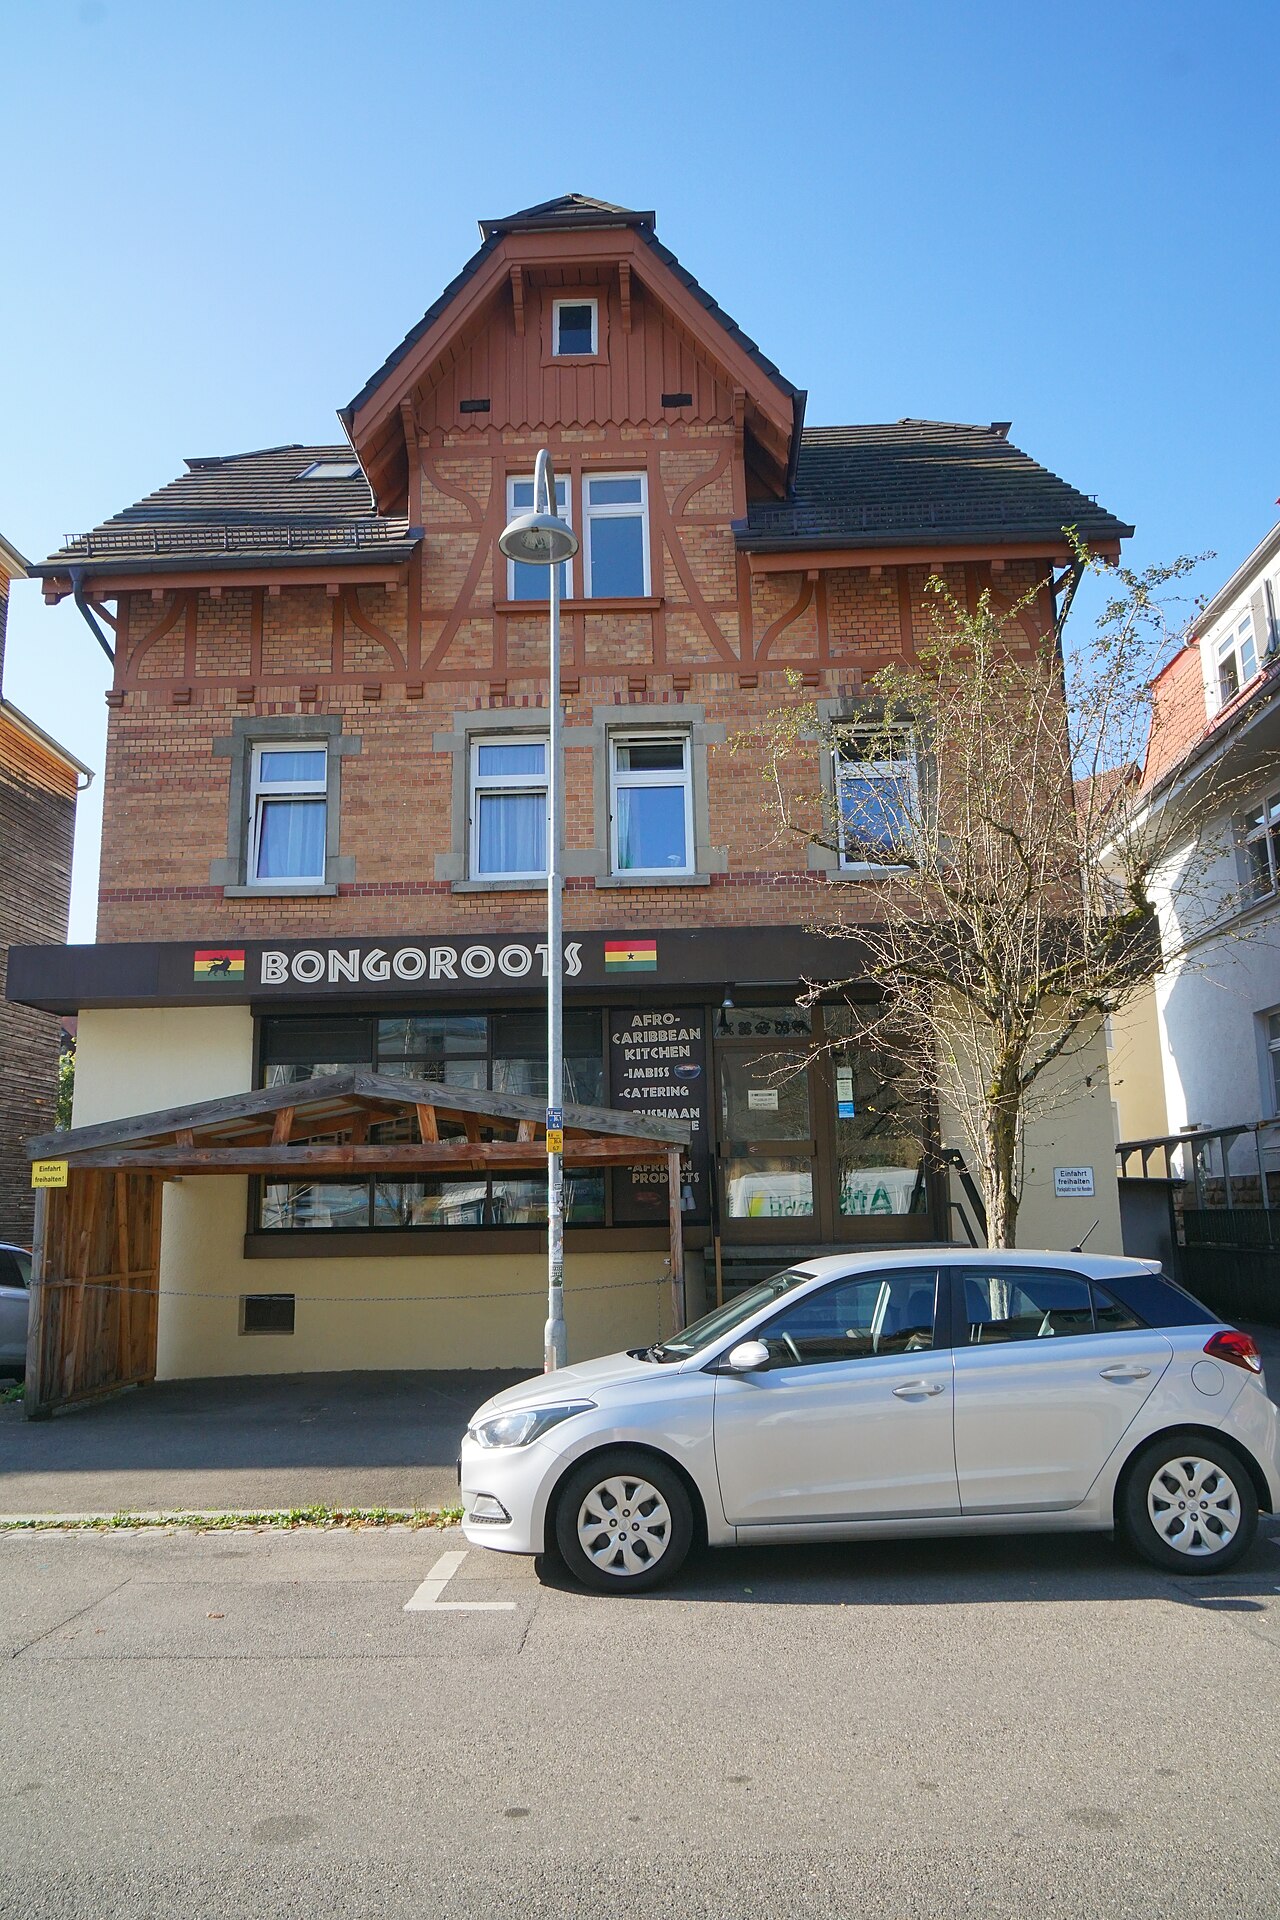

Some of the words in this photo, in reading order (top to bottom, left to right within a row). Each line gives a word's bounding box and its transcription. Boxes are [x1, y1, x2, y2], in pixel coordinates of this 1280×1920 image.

[261, 942, 583, 984] BONGOROOTS
[631, 1013, 680, 1027] AFRO-
[612, 1028, 701, 1044] CARIBBEAN
[624, 1045, 690, 1060] KITCHEN
[623, 1067, 670, 1078] -IMBISS
[619, 1086, 689, 1098] -CATERING
[632, 1172, 700, 1183] PRODCTS
